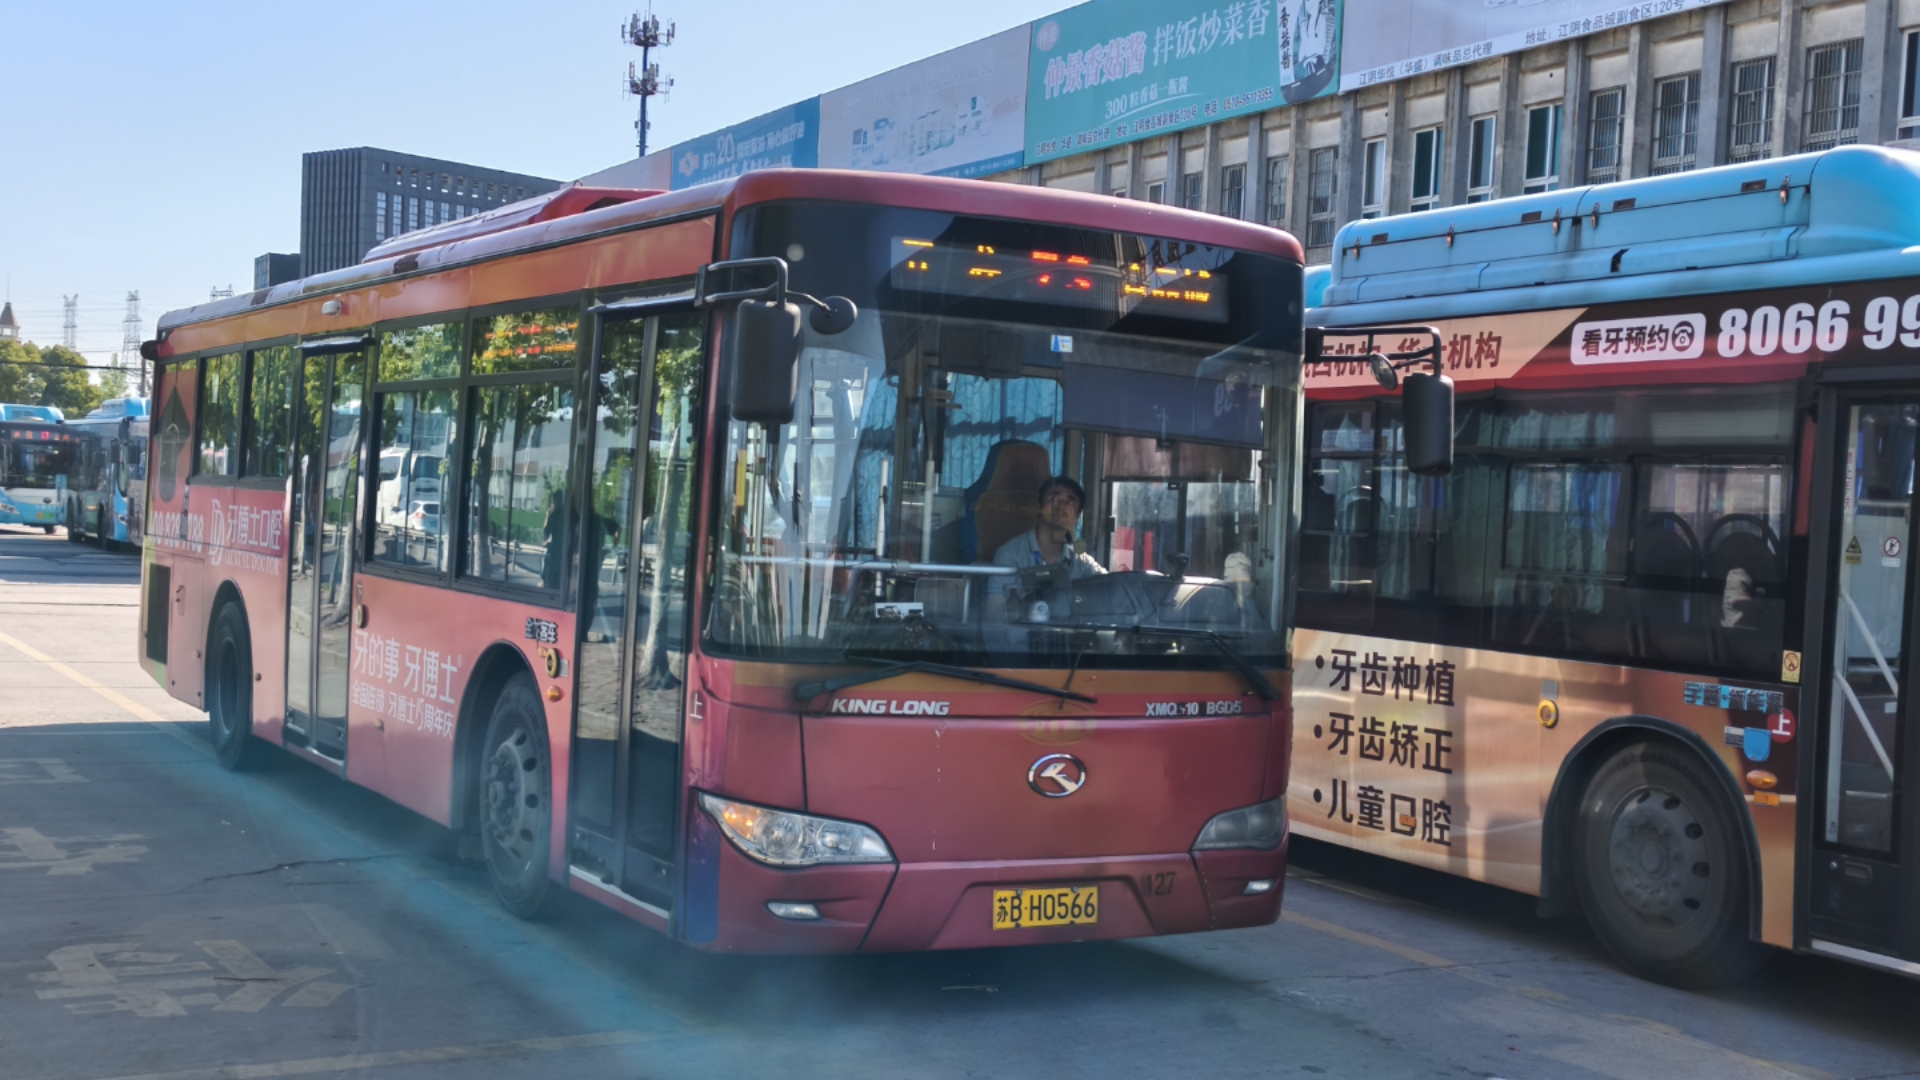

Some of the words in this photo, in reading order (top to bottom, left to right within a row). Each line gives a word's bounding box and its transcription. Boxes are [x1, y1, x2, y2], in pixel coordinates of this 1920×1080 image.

[1152, 1, 1270, 67] 拌饭炒菜香
[1558, 0, 1684, 38] 江阴食品城副食区120号
[1044, 31, 1147, 99] 仲景香菇酱
[1581, 325, 1670, 357] 看牙预约
[1717, 299, 1851, 358] 8066
[226, 504, 282, 550] 牙博士口腔
[353, 629, 400, 684] 牙的事
[403, 643, 459, 705] 牙博士
[1328, 648, 1456, 708] 牙齿种植
[690, 692, 704, 719] 上
[831, 698, 888, 714] KING
[889, 699, 949, 716] LONG
[1206, 701, 1242, 716] BGD5
[1771, 713, 1791, 736] 上
[1327, 712, 1453, 774] 牙齿矫正
[1327, 778, 1453, 848] 儿童口腔
[1144, 870, 1177, 896] 127
